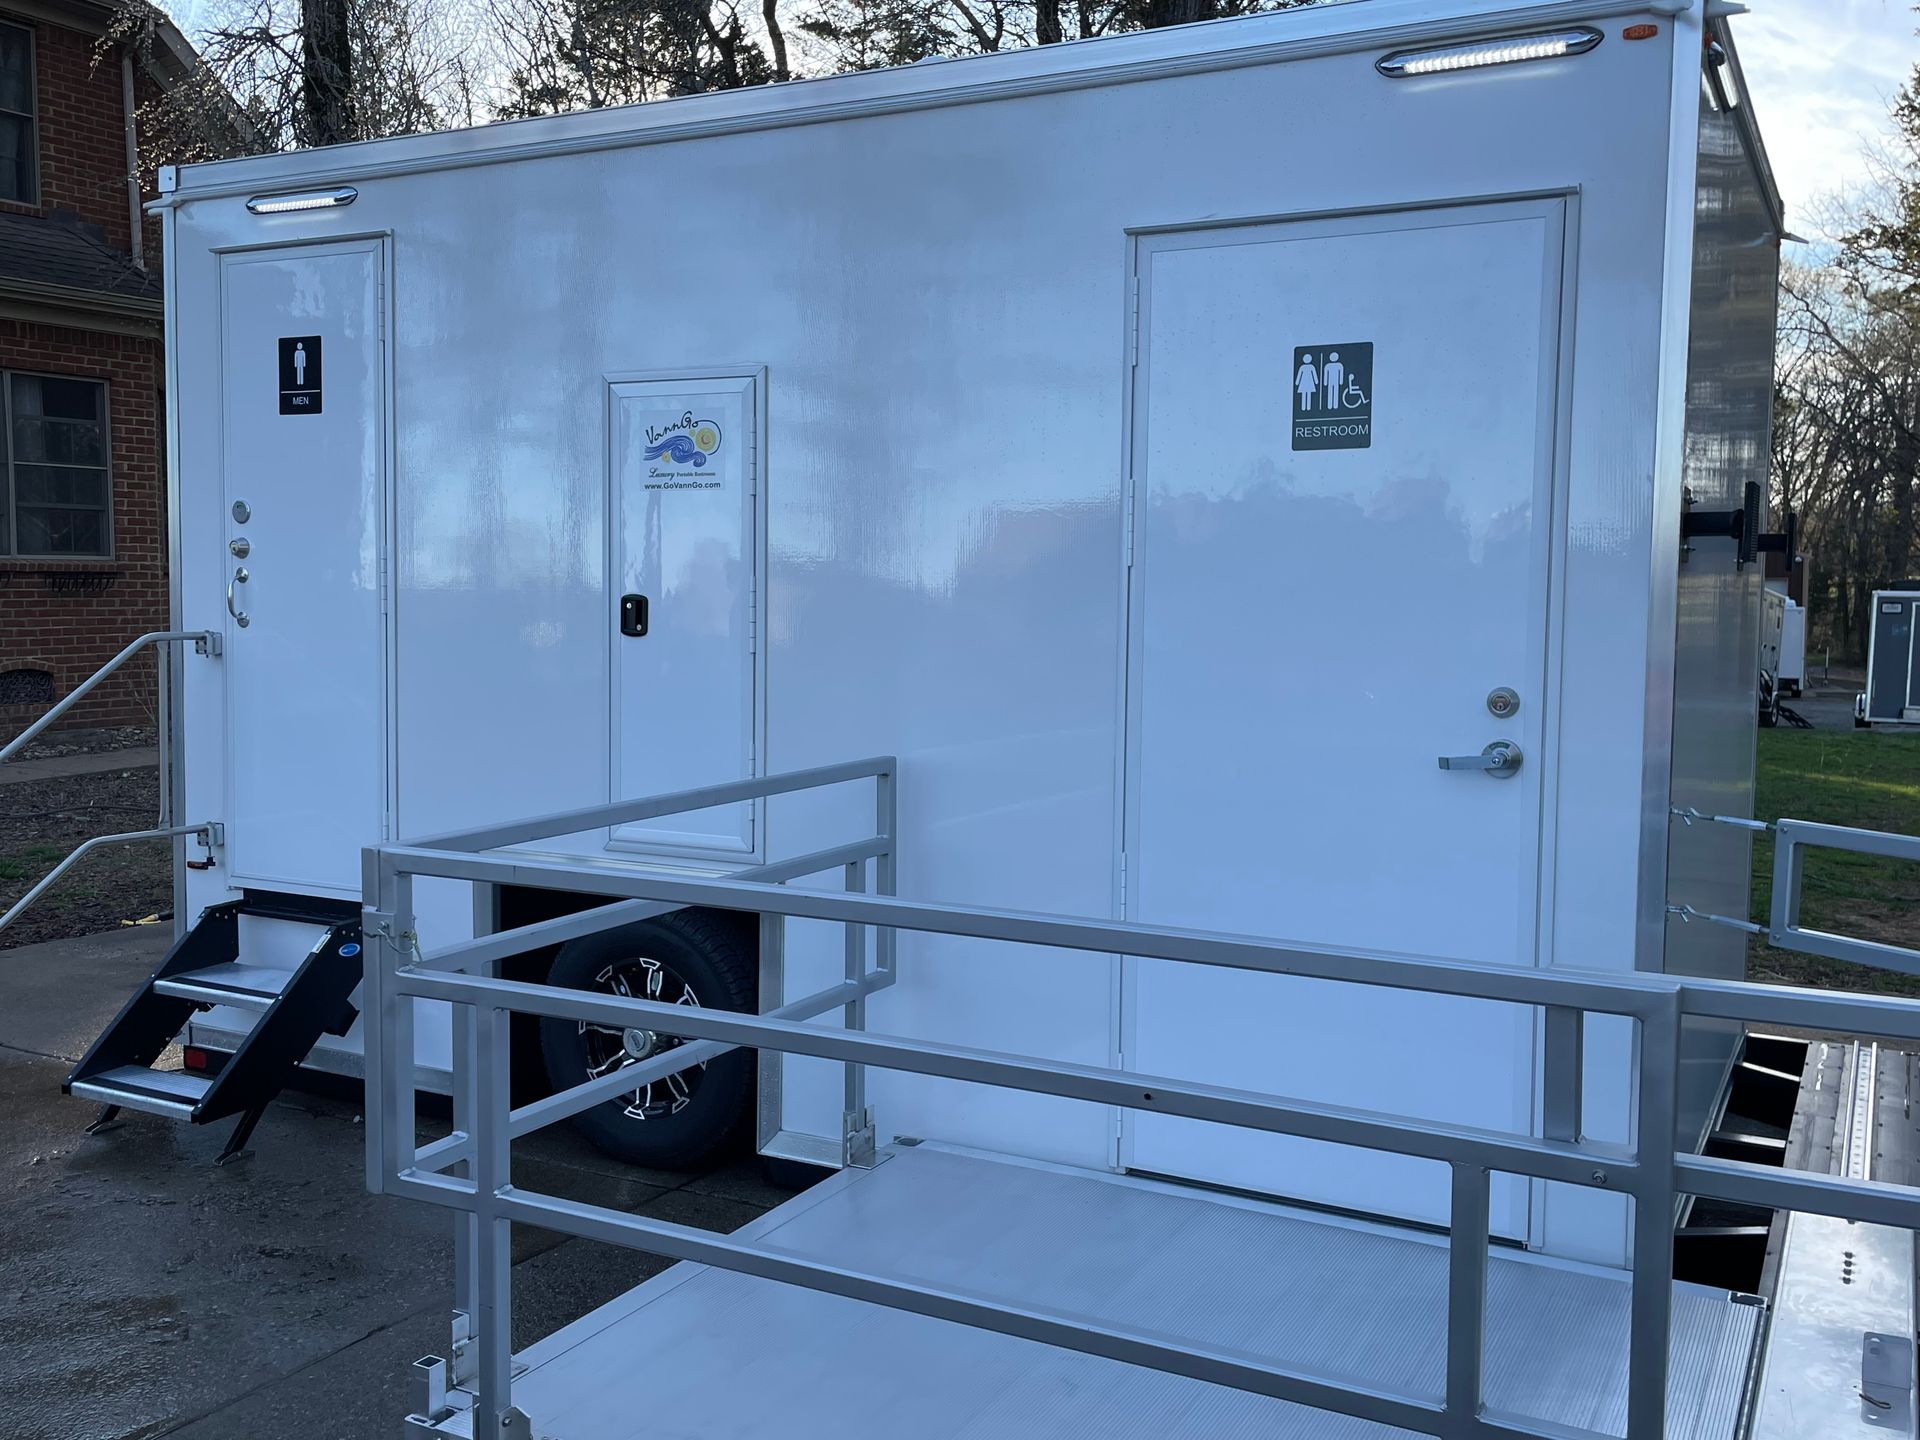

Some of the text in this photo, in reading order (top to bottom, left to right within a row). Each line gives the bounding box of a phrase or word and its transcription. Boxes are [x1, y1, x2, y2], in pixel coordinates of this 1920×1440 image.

[292, 396, 309, 405] MEN
[645, 410, 700, 444] VannGo
[1295, 424, 1369, 438] RESTROOM
[644, 481, 721, 490] www.GoVannGo.com
